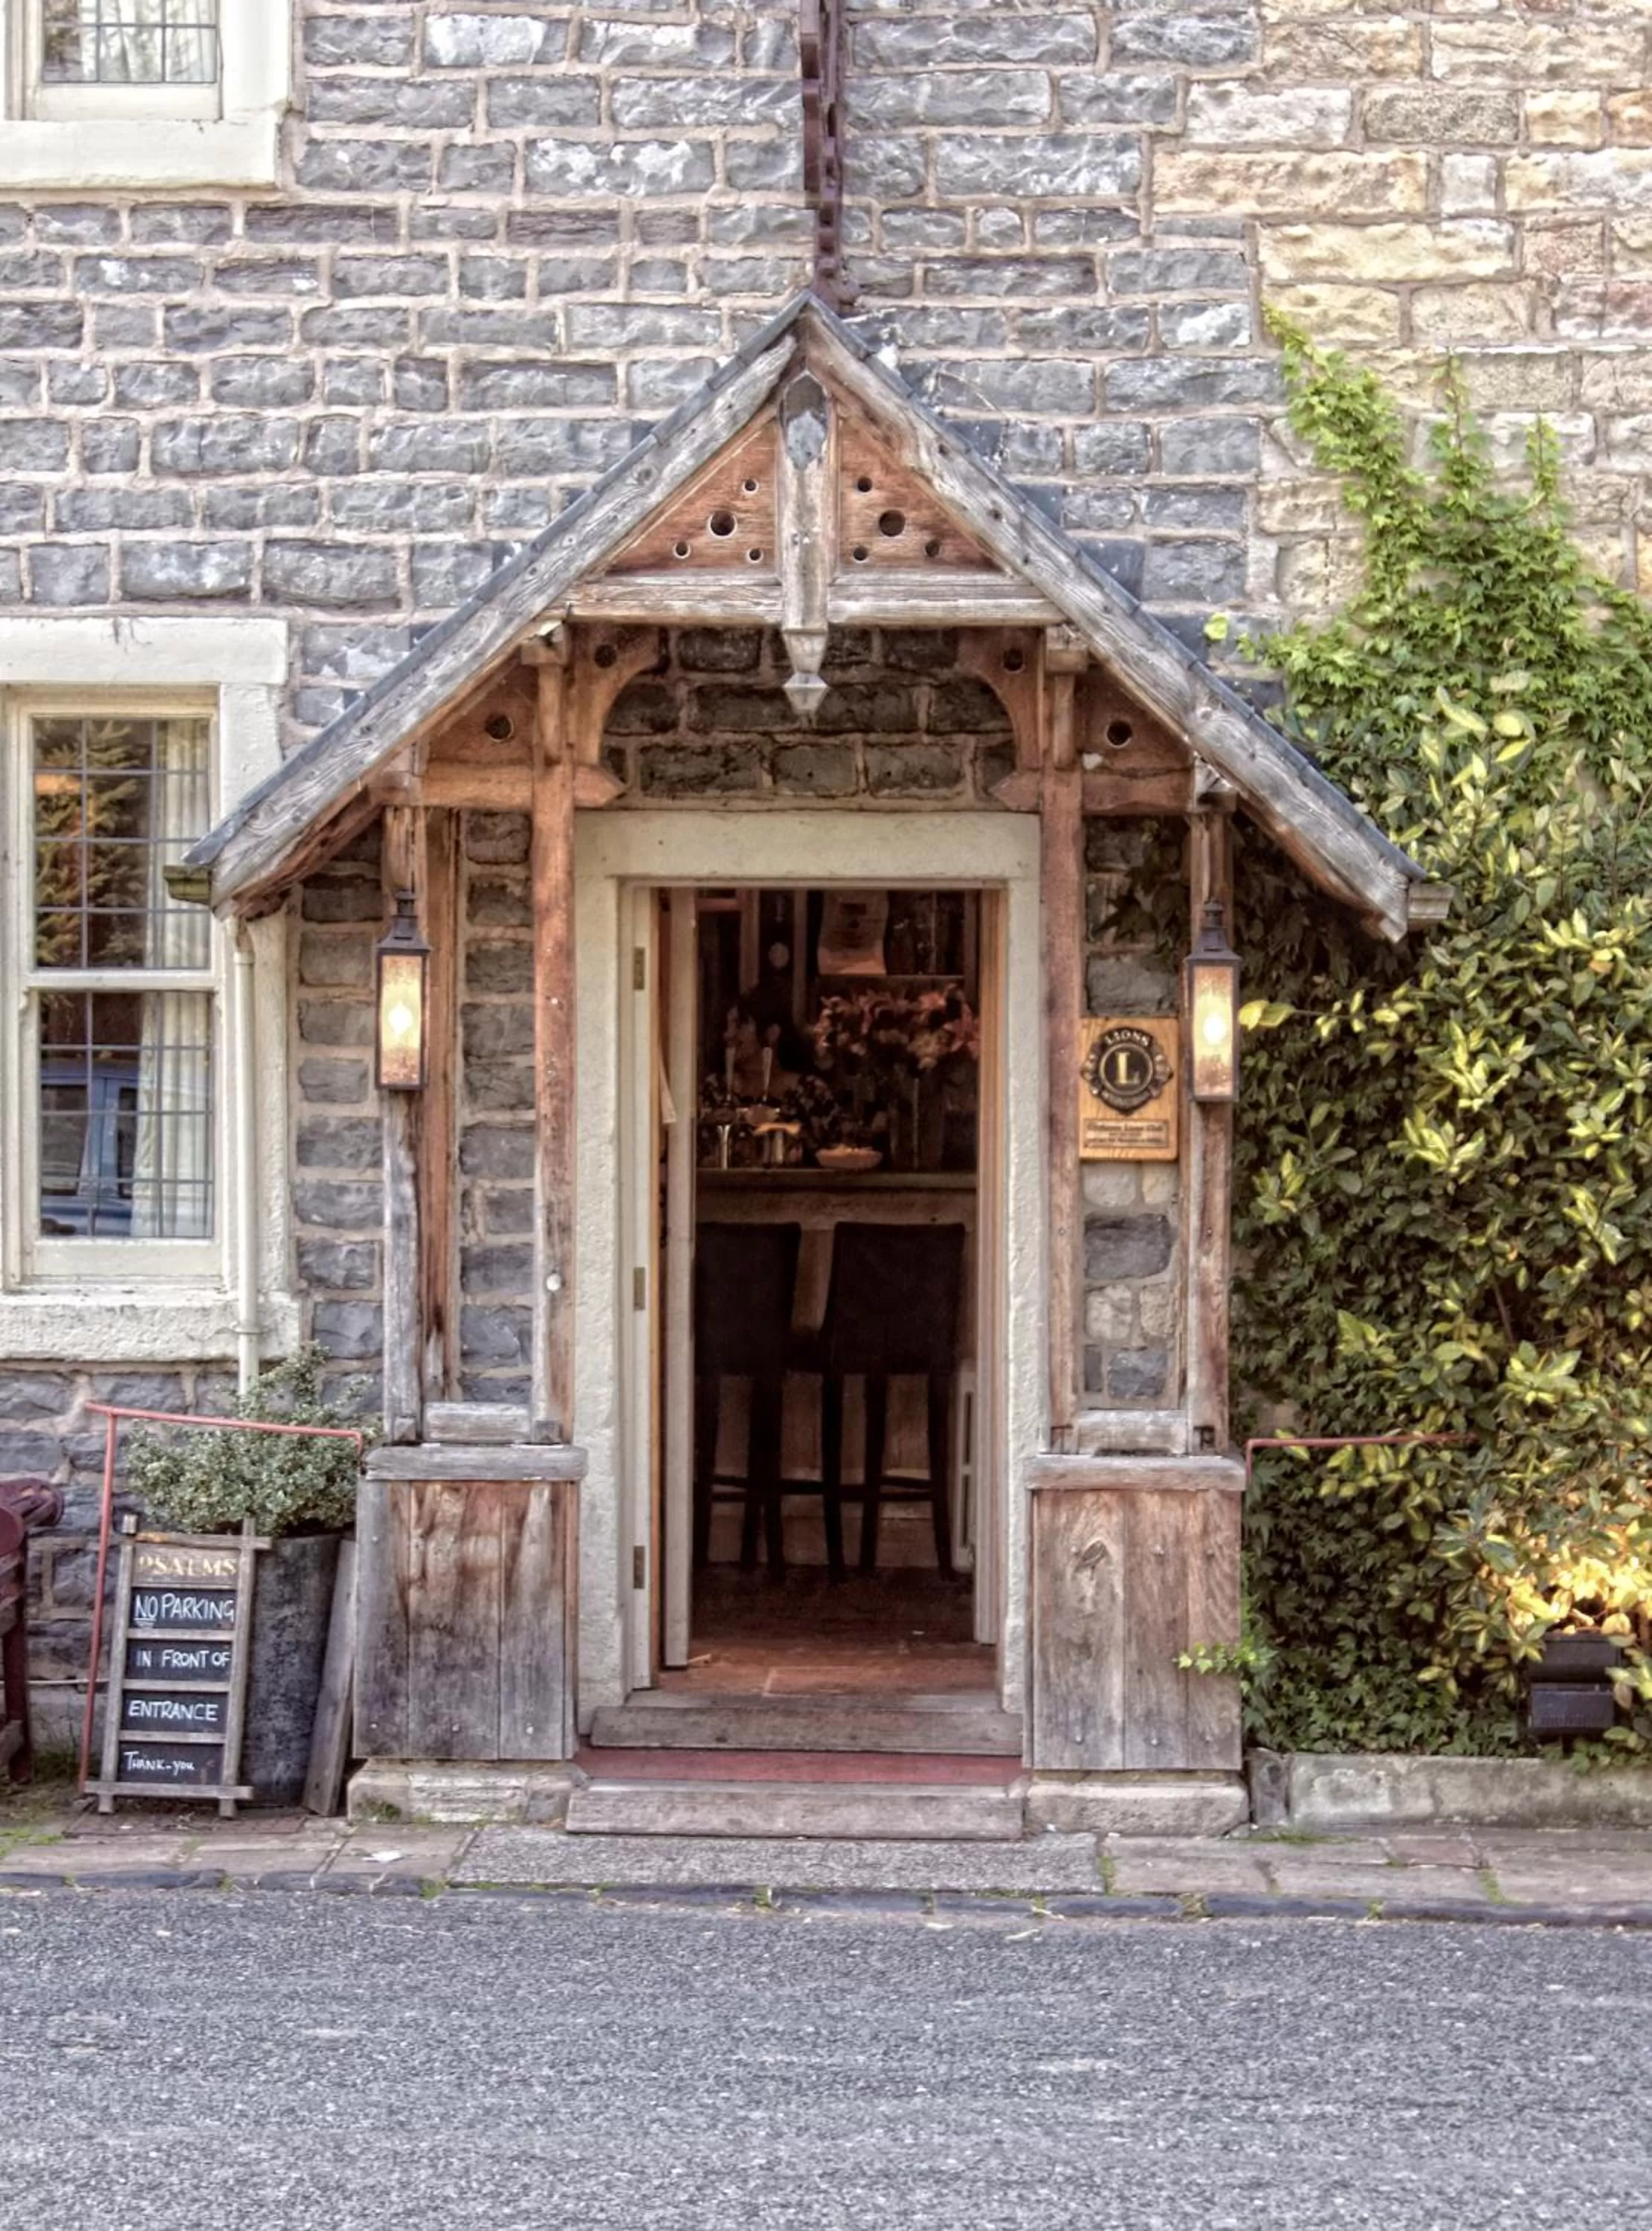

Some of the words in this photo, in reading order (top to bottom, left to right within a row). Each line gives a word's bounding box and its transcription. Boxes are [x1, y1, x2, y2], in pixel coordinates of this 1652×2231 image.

[1105, 1029, 1150, 1047] LIONS
[1116, 1052, 1140, 1084] L
[138, 1555, 236, 1576] PSALMS
[135, 1594, 158, 1618] NO
[161, 1592, 234, 1622] PARKING
[136, 1650, 151, 1667] IN
[162, 1649, 210, 1667] FRONT
[212, 1651, 231, 1667] OF
[128, 1700, 219, 1721] ENTRANCE
